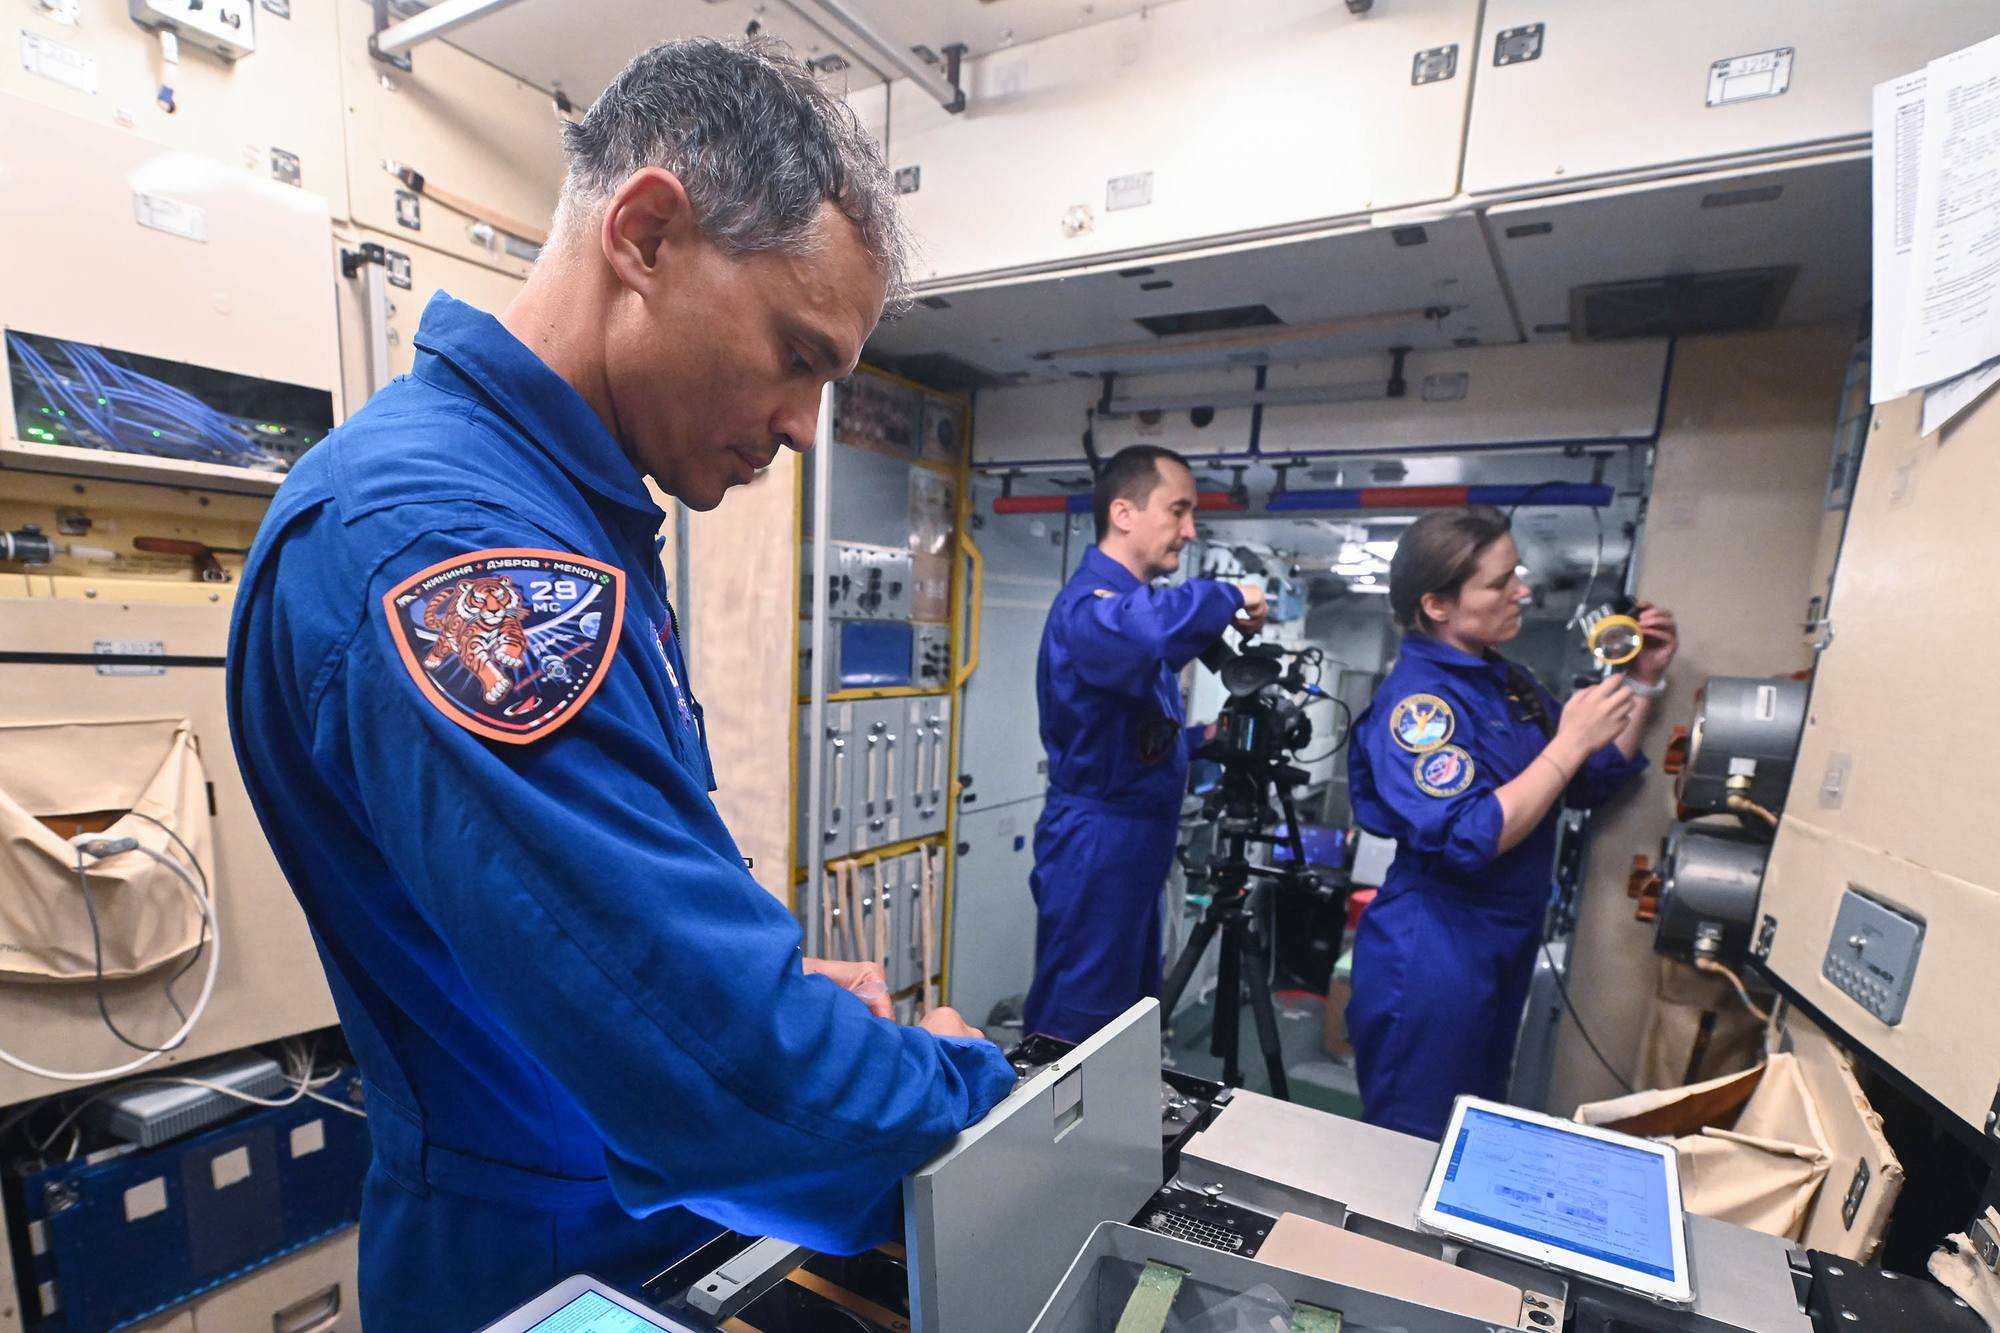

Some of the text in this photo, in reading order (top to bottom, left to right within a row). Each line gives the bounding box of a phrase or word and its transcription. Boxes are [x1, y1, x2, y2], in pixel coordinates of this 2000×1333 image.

[486, 559, 540, 570] ДУБРОВ
[553, 562, 598, 580] MENON
[529, 581, 577, 601] 29
